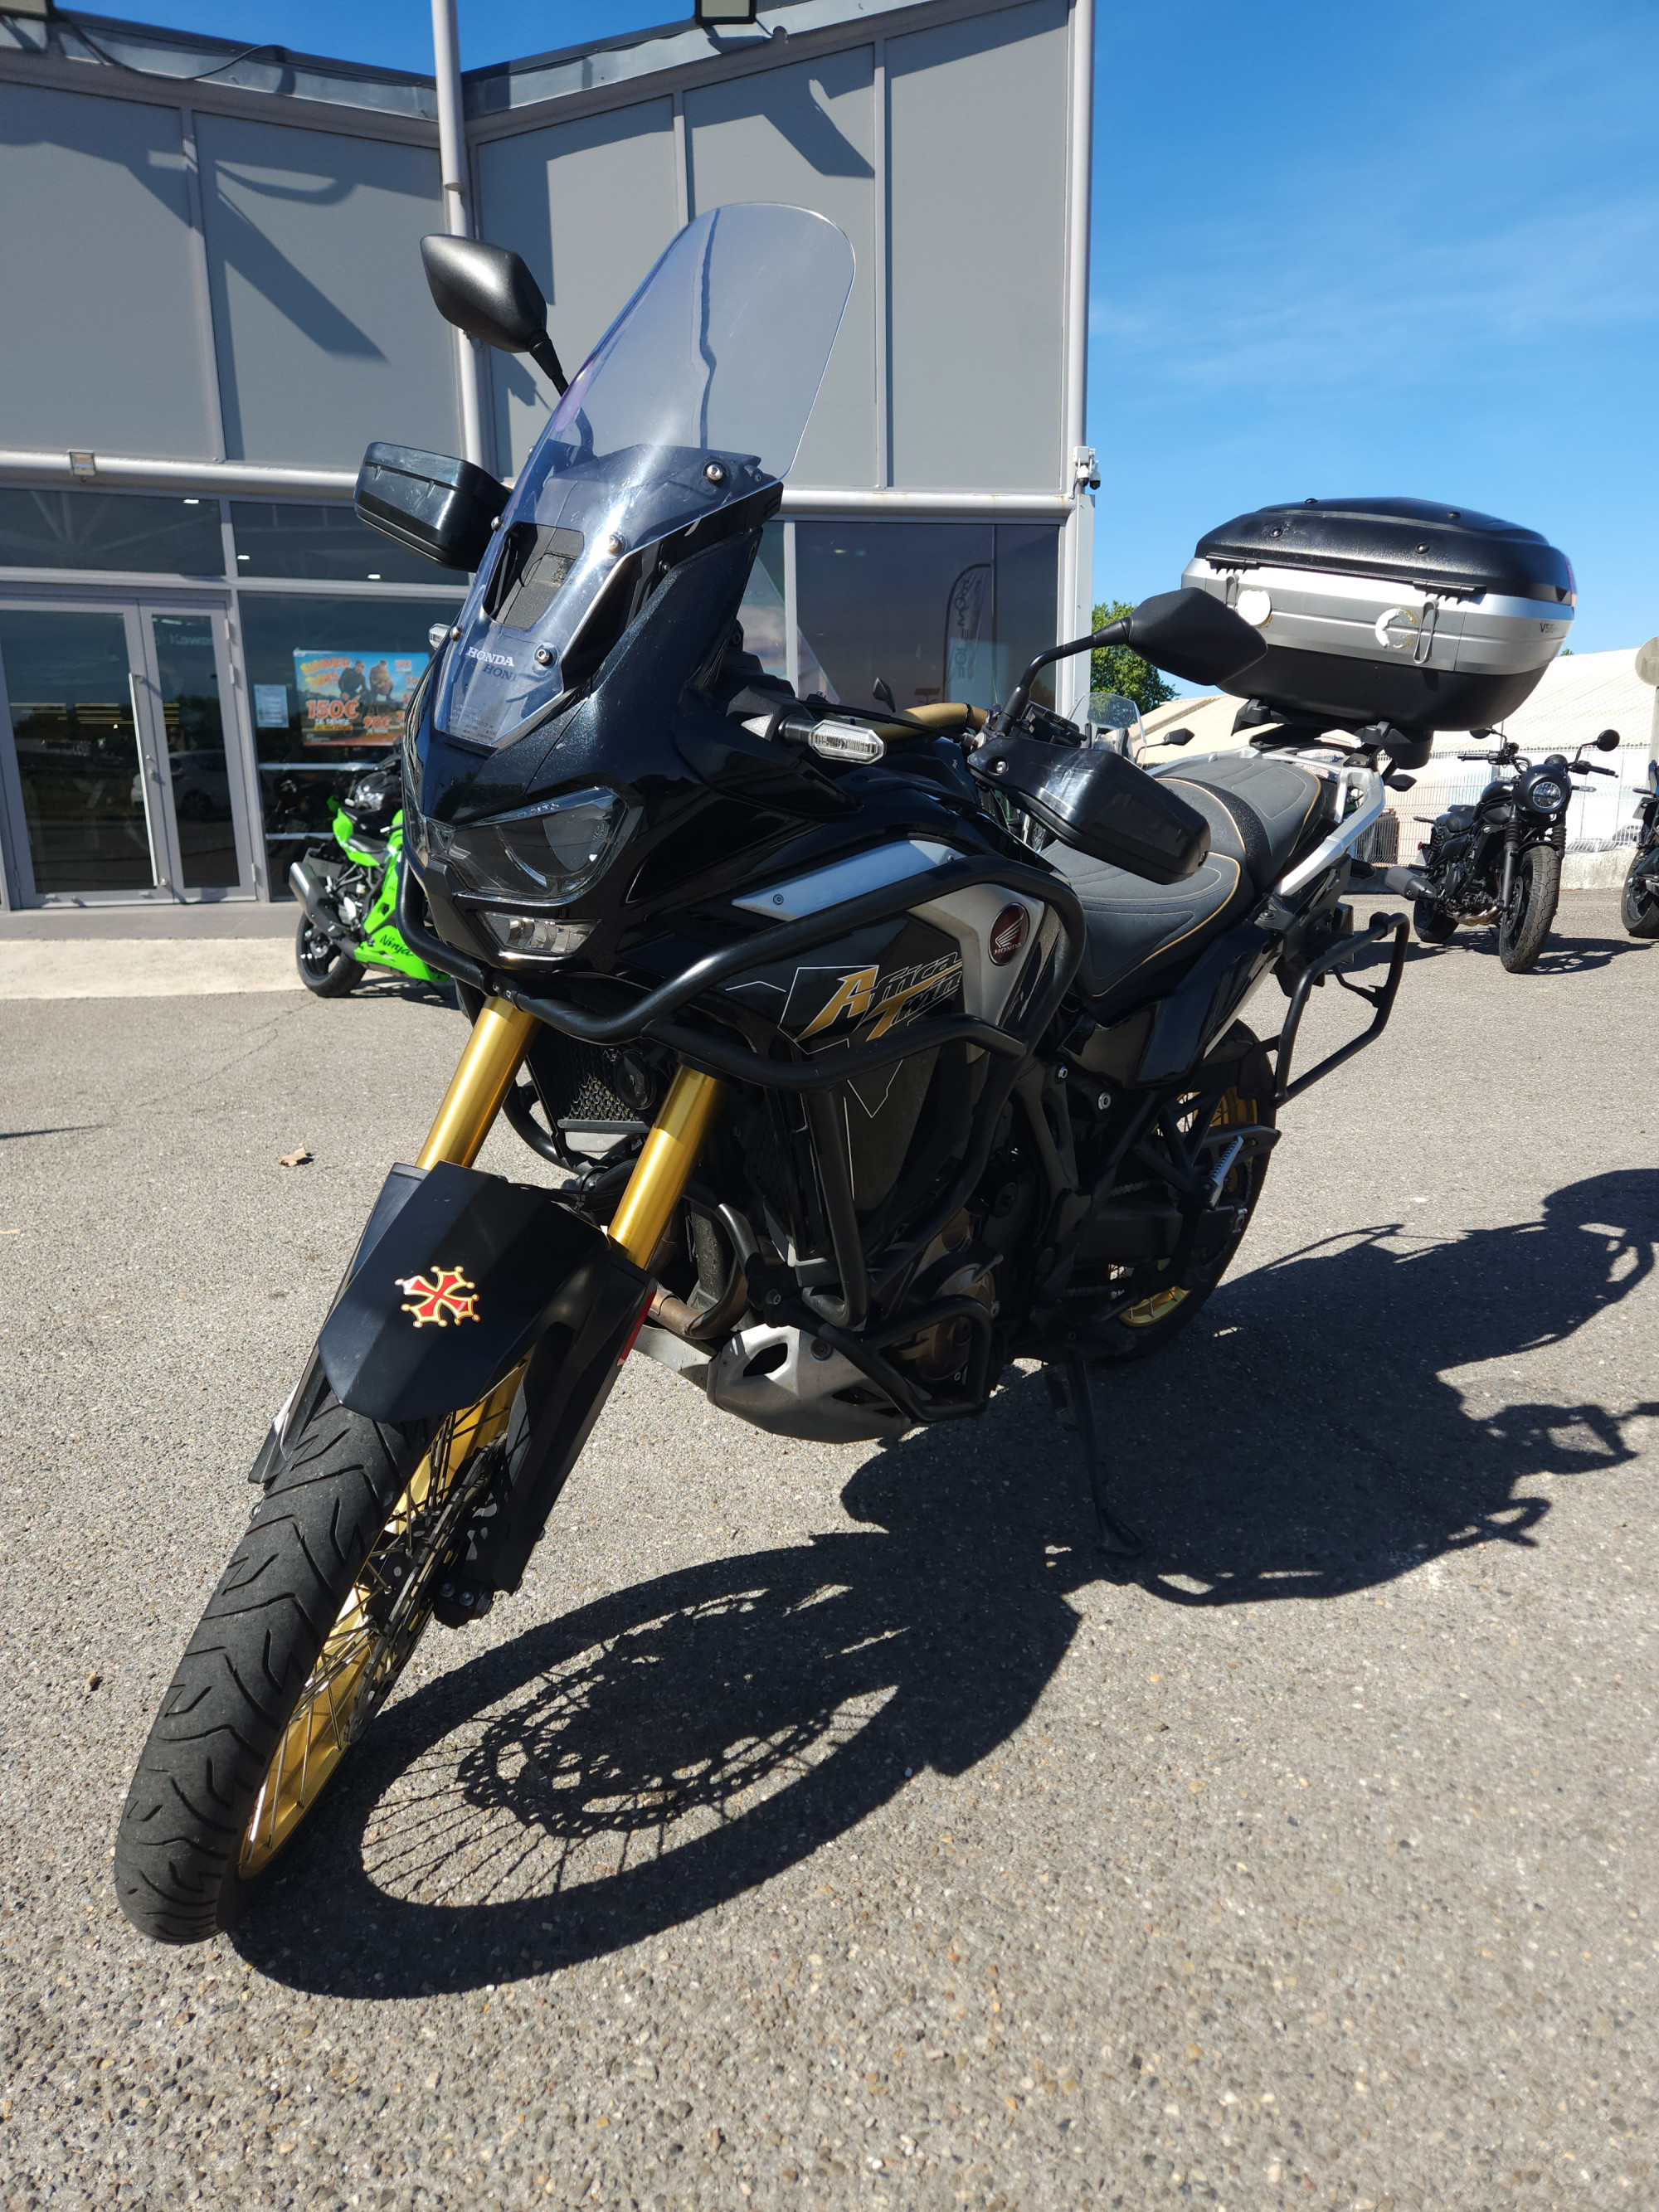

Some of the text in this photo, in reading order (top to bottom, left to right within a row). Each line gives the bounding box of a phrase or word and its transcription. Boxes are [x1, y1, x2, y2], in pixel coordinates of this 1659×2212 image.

[465, 646, 515, 667] HONDA
[305, 699, 360, 720] 150€
[362, 715, 392, 730] 90€
[379, 934, 414, 956] Ninja
[993, 941, 1023, 955] HONDA
[794, 951, 963, 1043] Africa
[863, 962, 963, 1043] Twin
